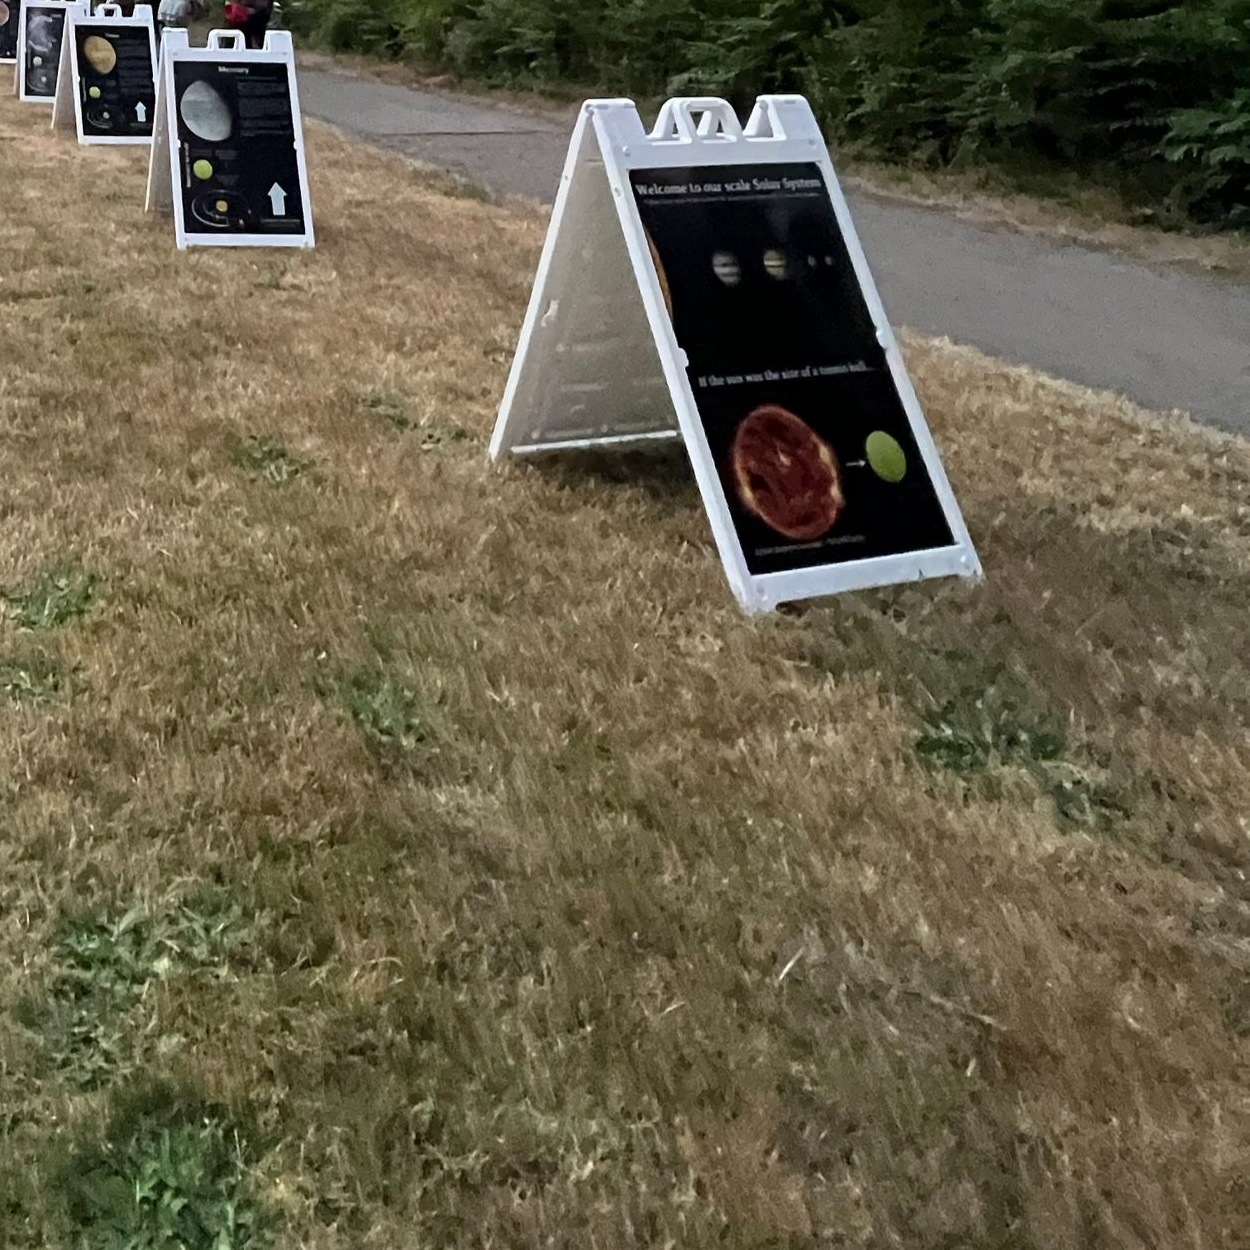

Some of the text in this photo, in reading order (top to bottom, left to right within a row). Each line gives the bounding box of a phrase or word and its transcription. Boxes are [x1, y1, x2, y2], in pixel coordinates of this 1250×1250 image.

[635, 177, 821, 195] Welcome to our scale Solar System
[708, 374, 724, 386] the
[764, 369, 780, 380] the
[801, 365, 812, 377] of
[812, 367, 818, 376] a
